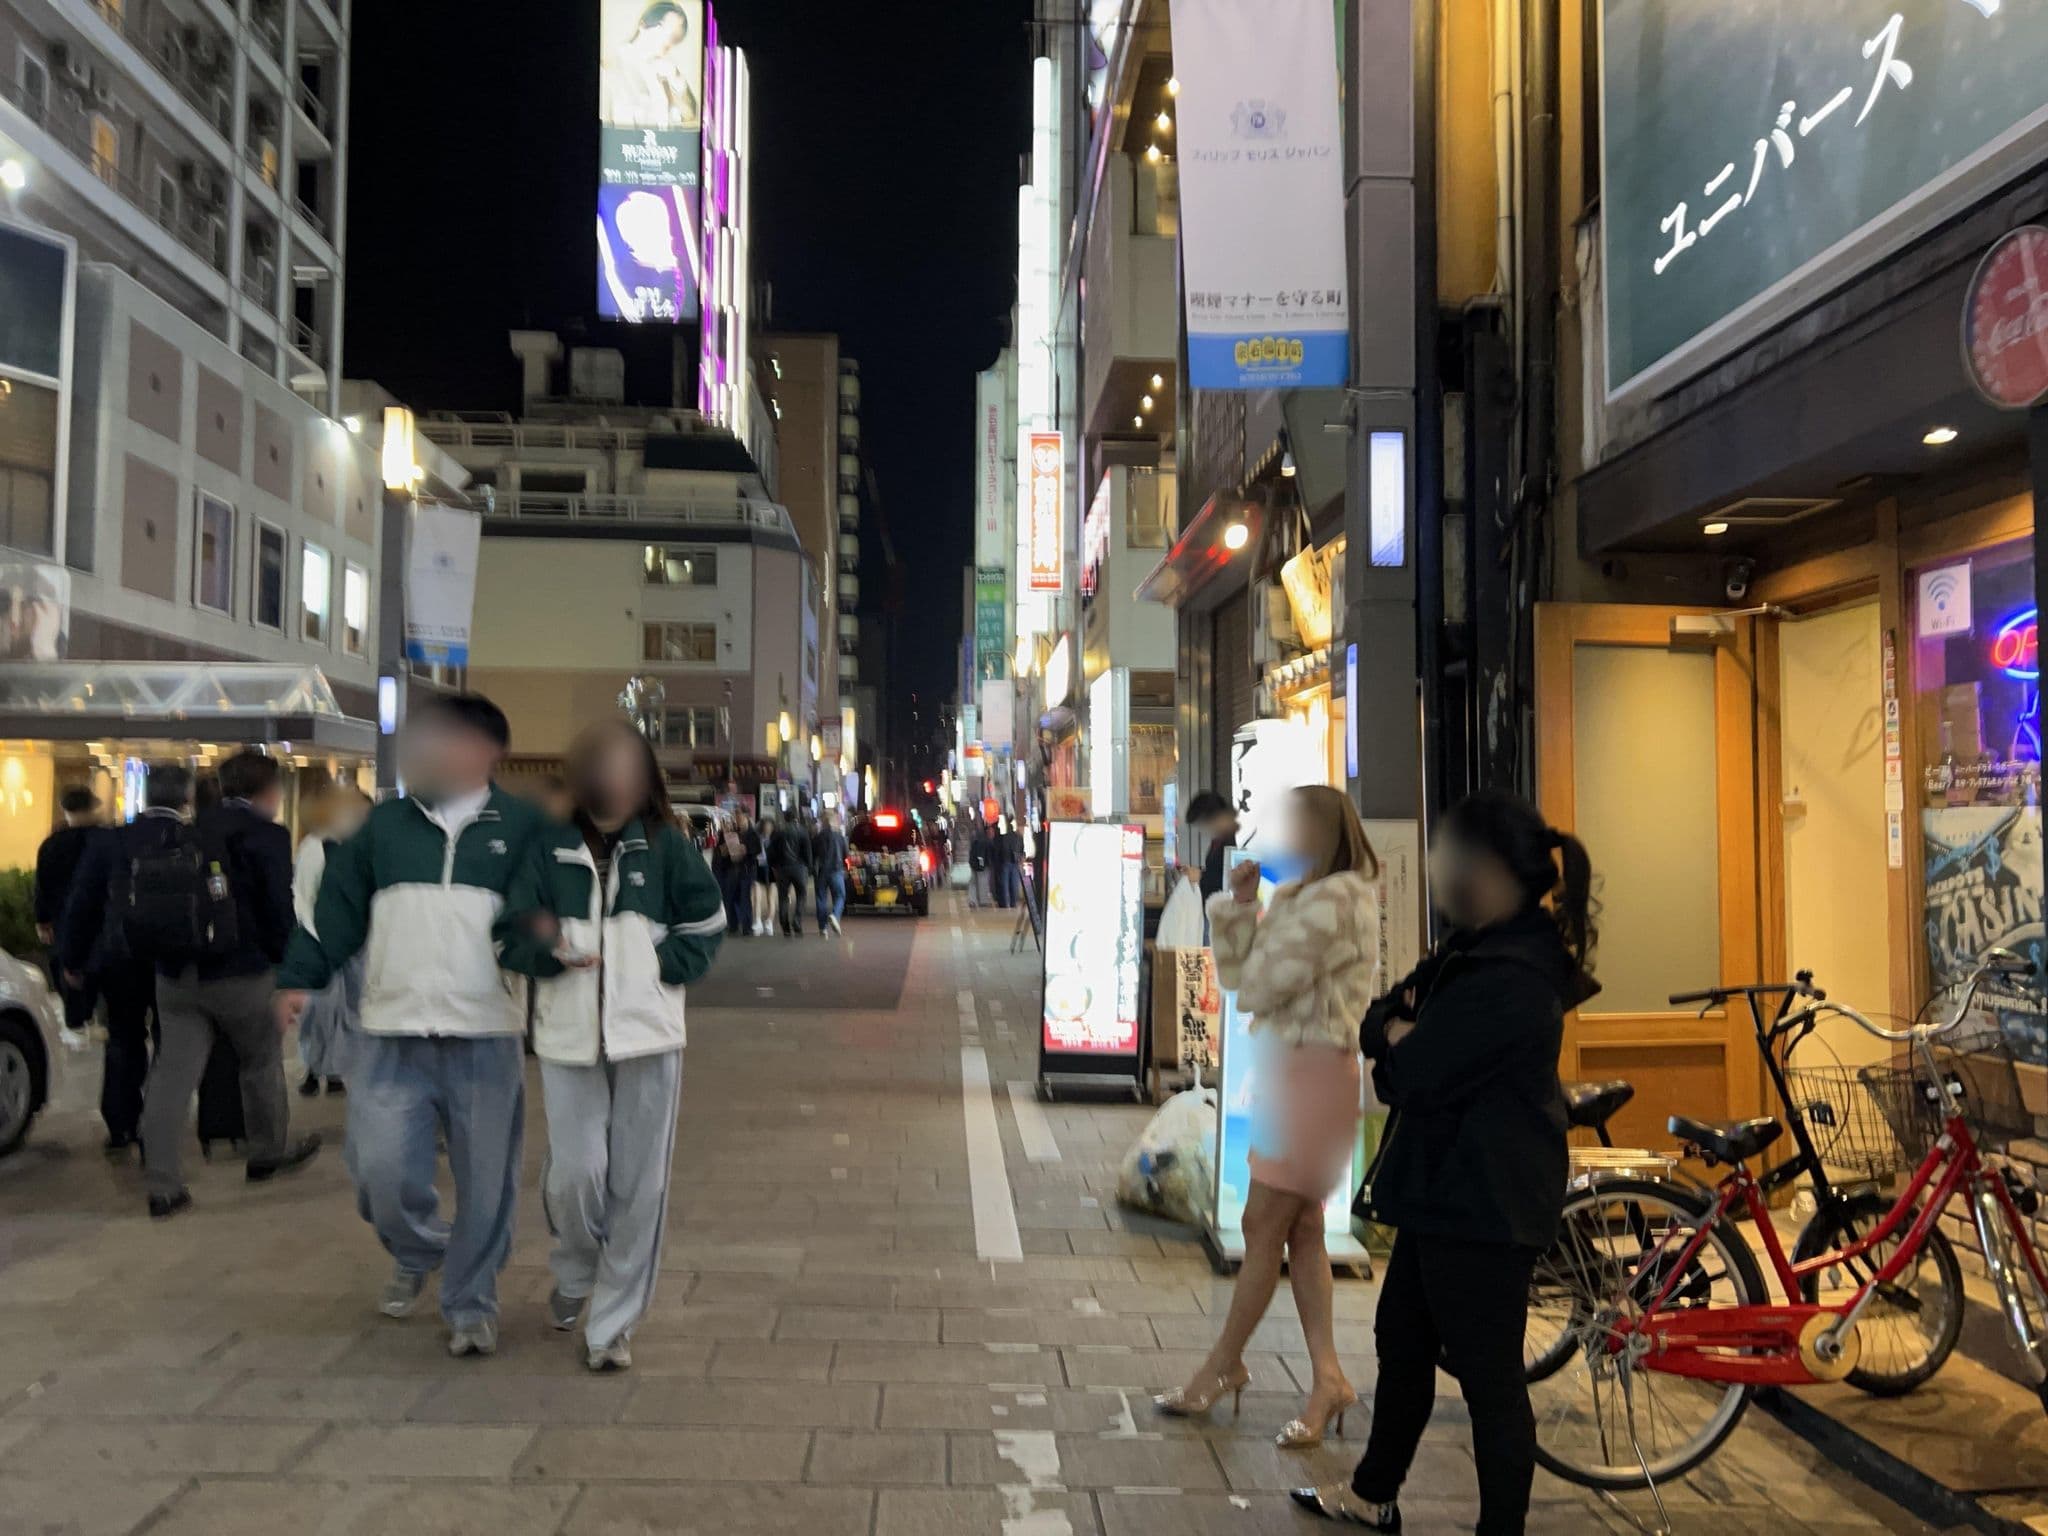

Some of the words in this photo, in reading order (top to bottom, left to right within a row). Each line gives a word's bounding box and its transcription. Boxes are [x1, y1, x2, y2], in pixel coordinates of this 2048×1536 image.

[1653, 12, 1913, 276] ユニバース
